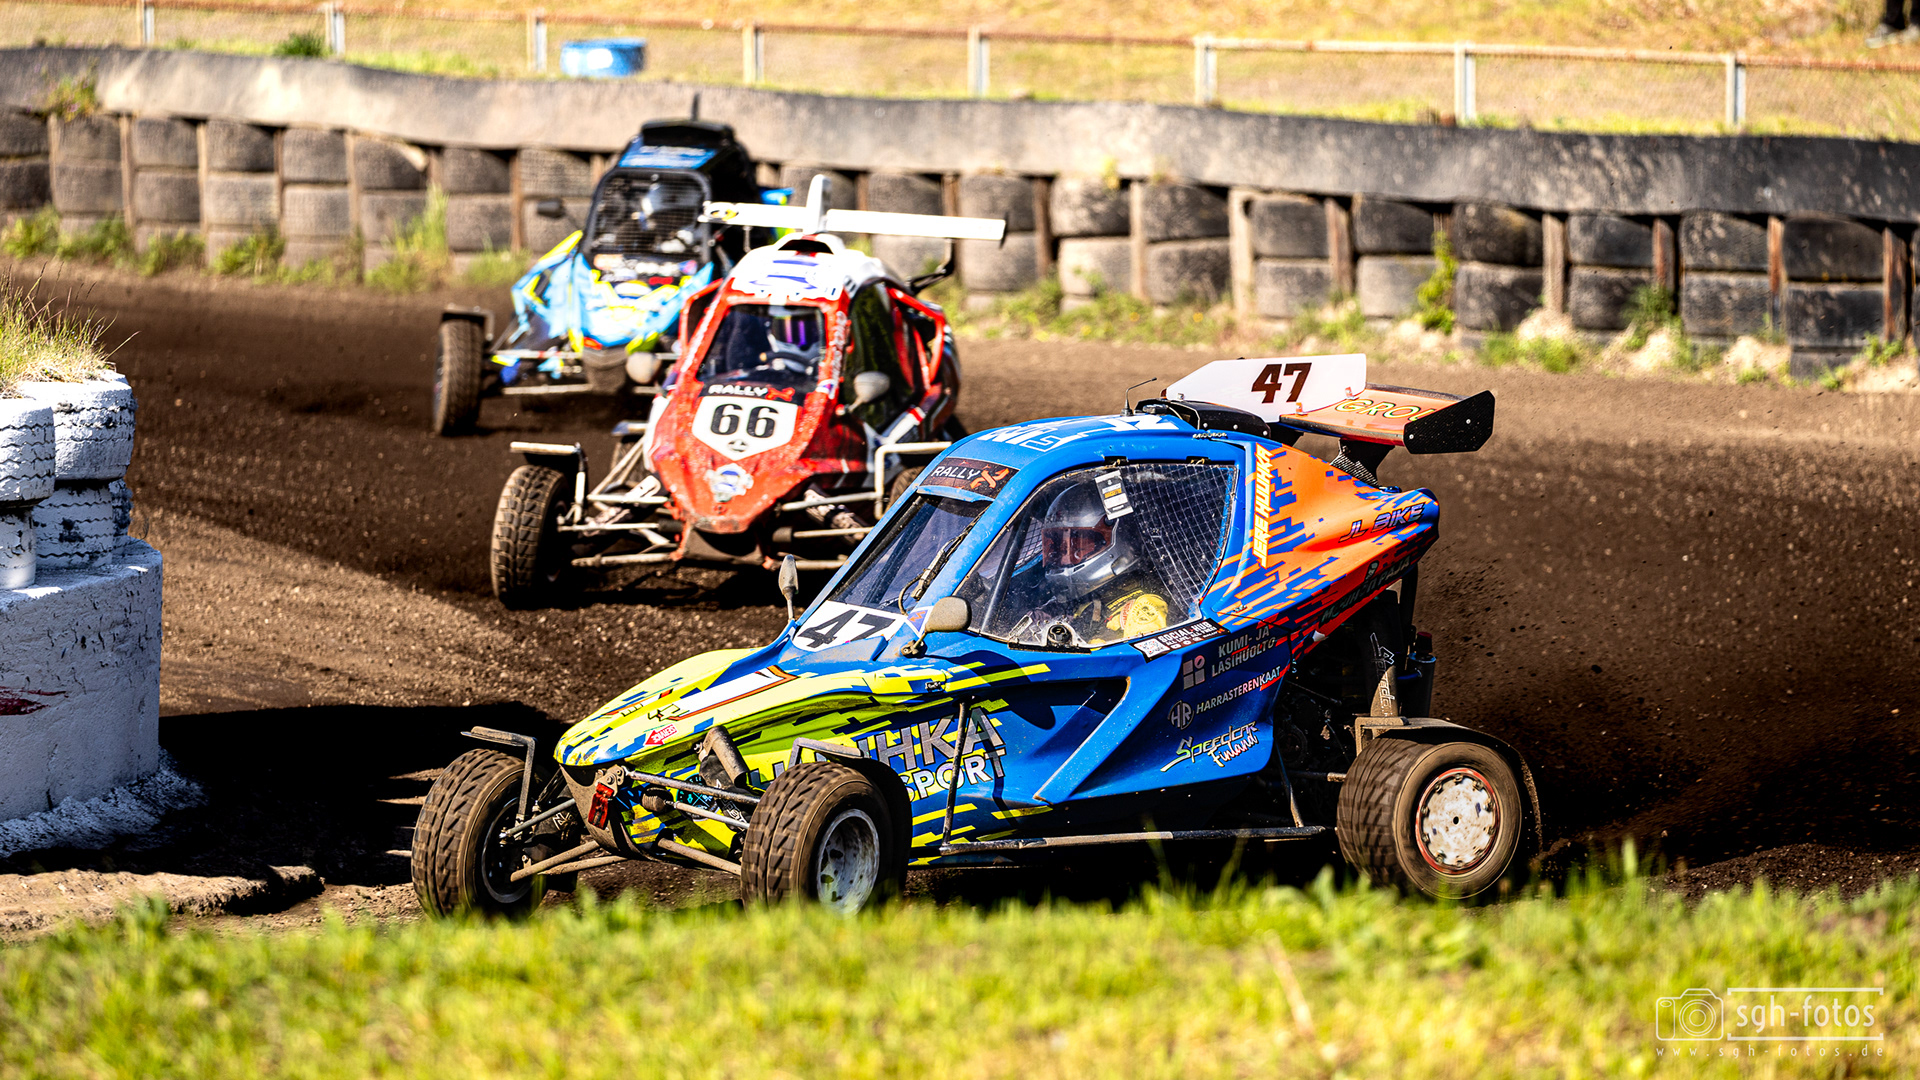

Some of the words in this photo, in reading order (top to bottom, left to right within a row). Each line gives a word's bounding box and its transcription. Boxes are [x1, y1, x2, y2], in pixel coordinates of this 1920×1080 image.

[1251, 362, 1312, 404] 47
[710, 403, 779, 439] 66
[1254, 442, 1276, 519] HUUHKA
[1370, 502, 1426, 533] BIKE
[1253, 513, 1273, 570] JERE
[797, 609, 896, 649] 47
[1255, 625, 1270, 641] JA
[1211, 637, 1276, 678] LASIHUOLTO
[1196, 665, 1281, 714] HARRASTERENKAAT
[1207, 732, 1259, 767] Finland
[899, 747, 1007, 802] SPORT
